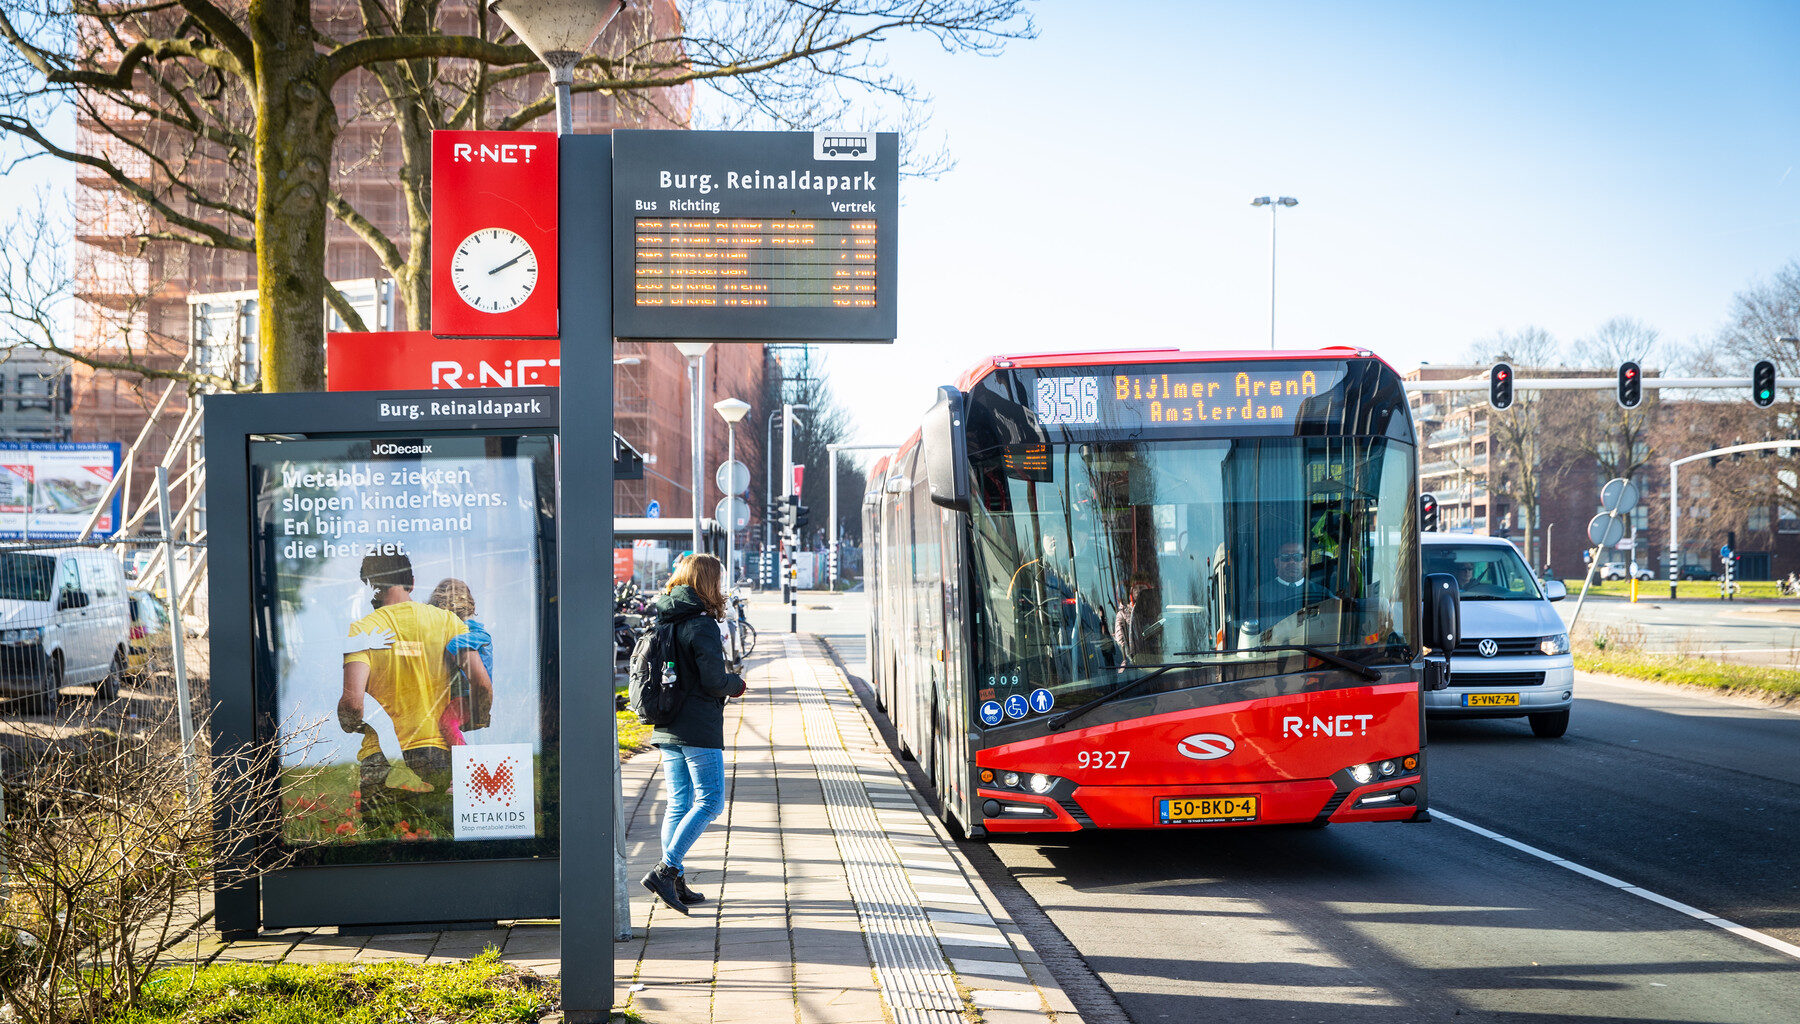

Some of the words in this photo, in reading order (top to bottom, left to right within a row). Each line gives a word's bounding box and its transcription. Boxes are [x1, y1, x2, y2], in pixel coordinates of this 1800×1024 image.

[659, 170, 719, 194] Burg.
[727, 170, 877, 195] Reinaldapark
[635, 199, 657, 211] Bus
[669, 199, 721, 214] Richting
[831, 201, 876, 213] Vertrek
[380, 403, 425, 420] Burg.
[431, 399, 541, 417] Reinaldapark
[1037, 376, 1099, 424] 356
[1115, 374, 1220, 400] Bijlmer
[1150, 399, 1284, 422] Amsterdam
[372, 444, 433, 455] JCDecaux
[283, 469, 385, 488] Metabole
[390, 467, 471, 487] ziekten
[282, 495, 354, 516] slopen
[361, 490, 508, 510] kinderlevens.
[284, 518, 309, 536] En
[316, 517, 370, 539] bijna
[376, 513, 473, 534] niemand
[283, 541, 317, 559] die
[323, 540, 359, 558] het
[364, 538, 412, 557] ziet.
[1471, 695, 1516, 705] 5-VNZ-74
[1077, 751, 1131, 770] 9327
[461, 811, 525, 822] METAKIDS
[1173, 800, 1251, 816] 50-BKD-4
